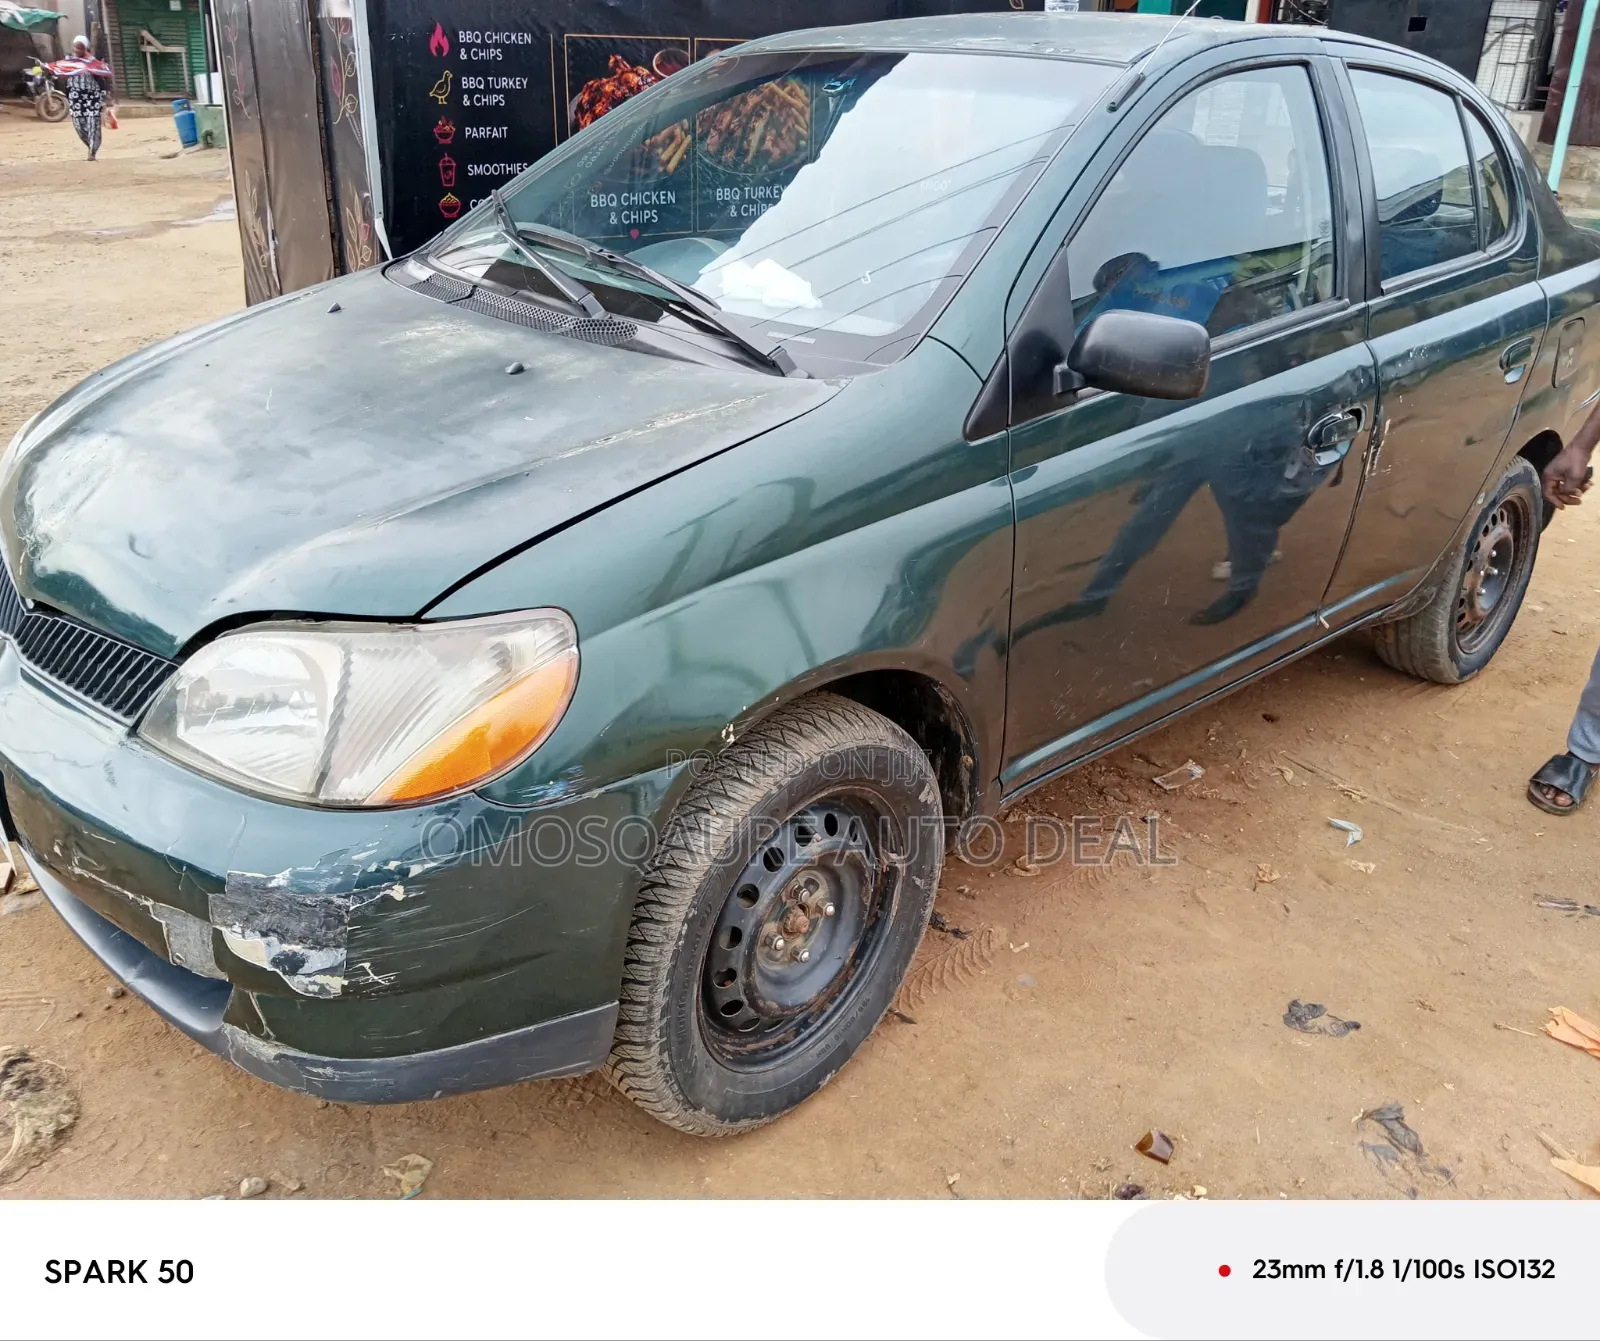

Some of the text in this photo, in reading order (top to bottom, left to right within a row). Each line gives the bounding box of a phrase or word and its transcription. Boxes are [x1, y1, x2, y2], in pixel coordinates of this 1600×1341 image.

[458, 31, 532, 44] BBQ CHICKEN
[459, 48, 503, 60] & CHIPS
[461, 77, 528, 90] BBQ TURKEY
[462, 94, 506, 106] & CHIPS
[465, 126, 508, 139] PARFAIT
[590, 190, 676, 208] BBQ CHICKEN
[716, 187, 740, 201] BBQ
[609, 209, 659, 225] & CHIPS
[729, 205, 738, 218] &
